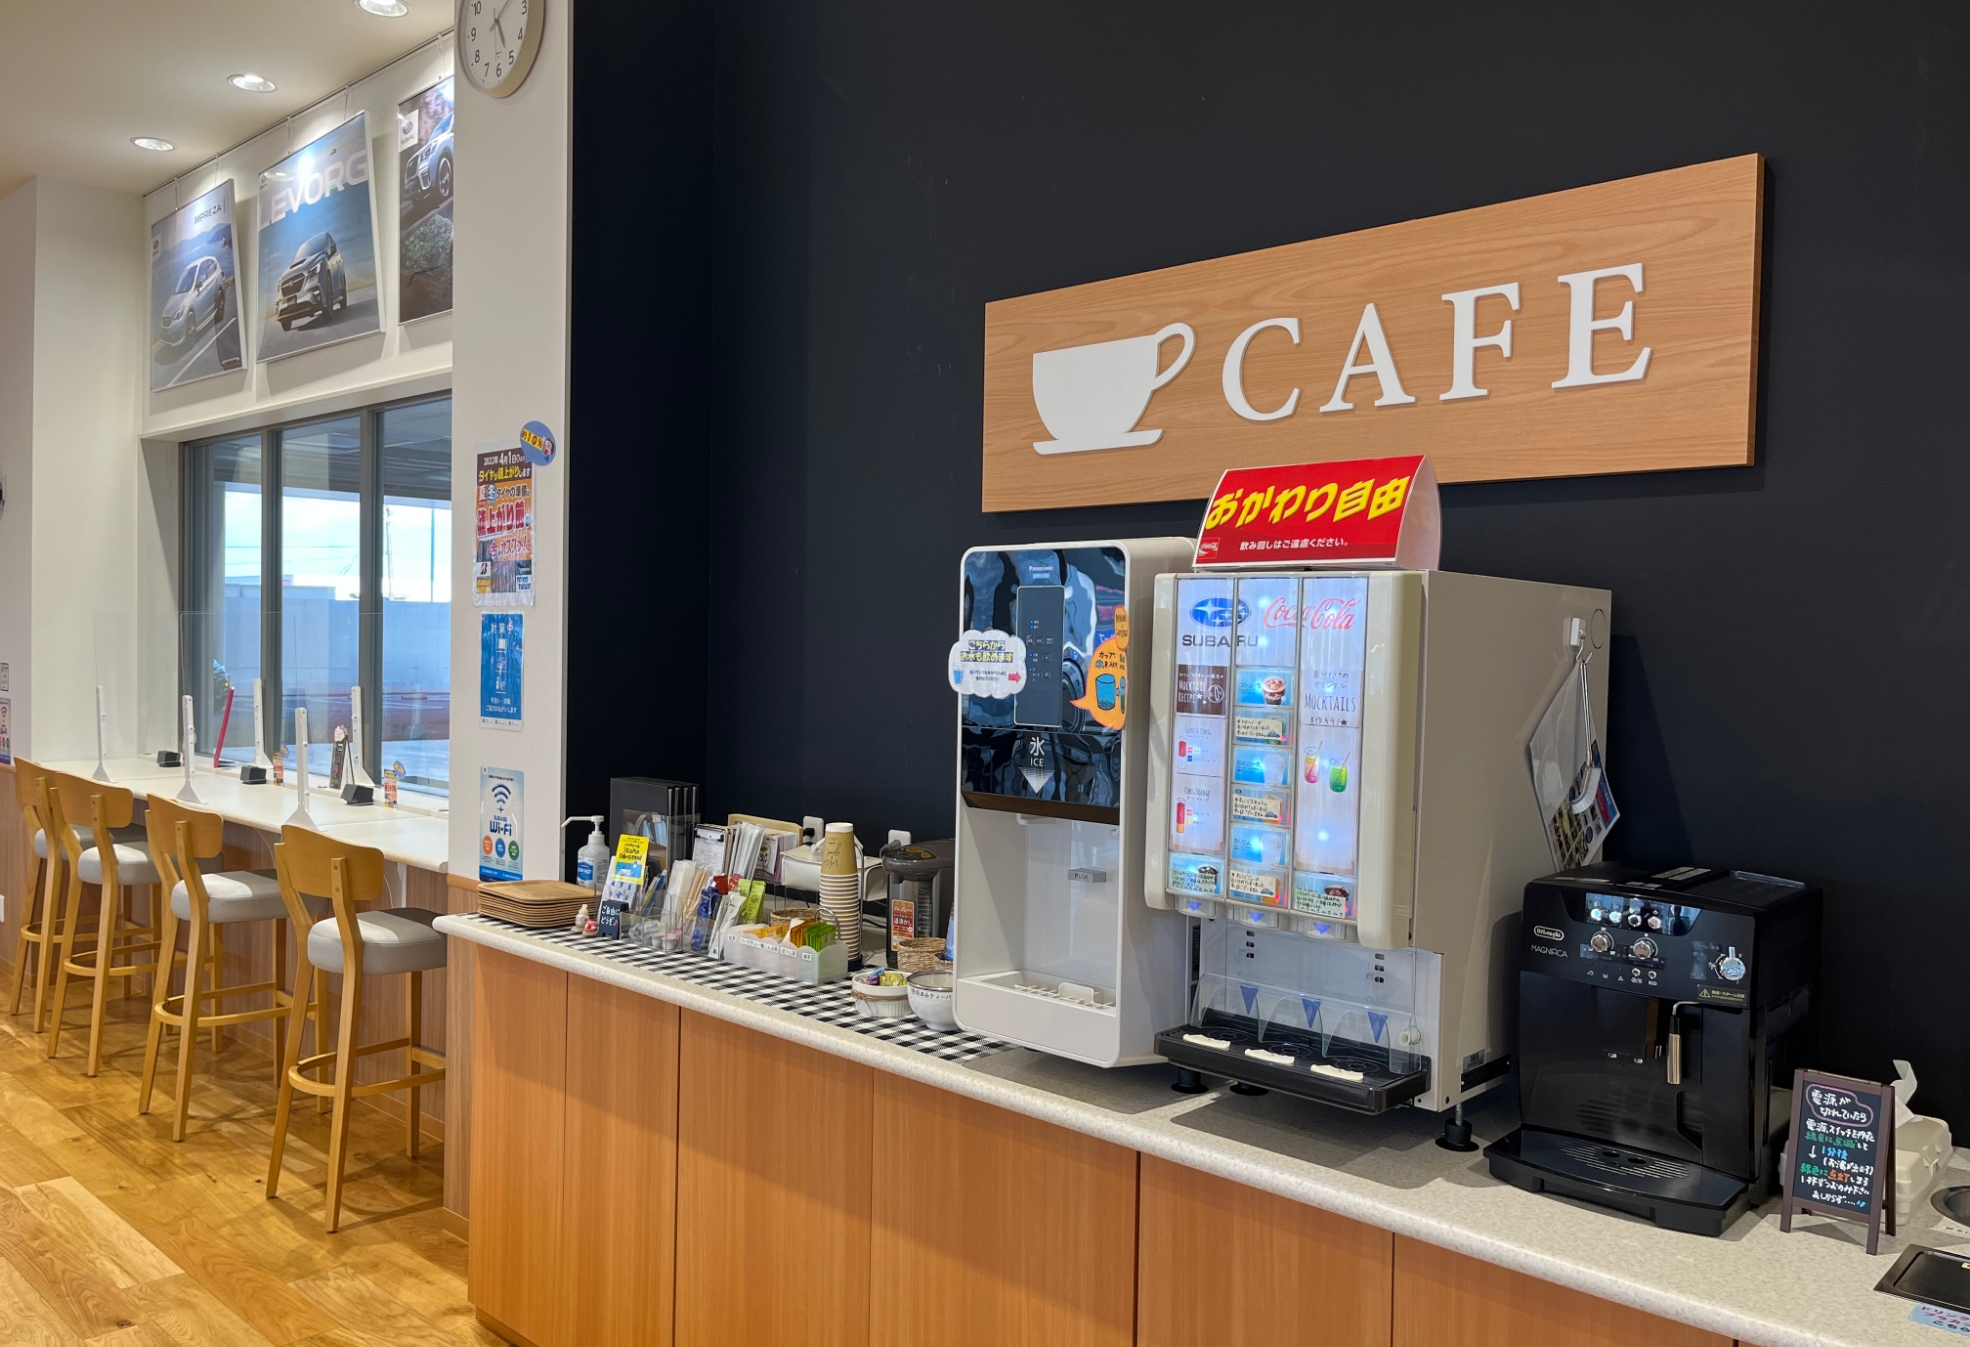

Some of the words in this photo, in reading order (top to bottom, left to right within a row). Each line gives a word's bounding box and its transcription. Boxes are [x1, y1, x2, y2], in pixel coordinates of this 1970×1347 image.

[473, 0, 482, 16] 10
[521, 0, 528, 15] 3
[470, 27, 477, 42] 9
[517, 27, 524, 41] 4
[474, 49, 481, 64] 8
[508, 49, 515, 65] 5
[484, 62, 490, 78] 7
[495, 63, 502, 78] 6
[193, 203, 222, 225] IMPREZA
[1221, 262, 1652, 422] CAFE
[1205, 476, 1410, 530] おかわり自由
[1240, 538, 1349, 551] 飲み回しはご遠慮ください。
[1264, 596, 1361, 631] Coca-Cola
[968, 640, 1006, 650] こちらから
[1182, 634, 1259, 647] SUBARU
[960, 651, 1013, 662] お水も飲めます
[1304, 692, 1356, 712] MOCKTAILS
[1030, 736, 1046, 757] 氷
[1030, 757, 1044, 767] ICE
[489, 820, 512, 836] Wi-Fi
[602, 904, 621, 916] ご自由に
[1811, 1088, 1851, 1106] 電源が
[1820, 1106, 1867, 1122] 切れていたら
